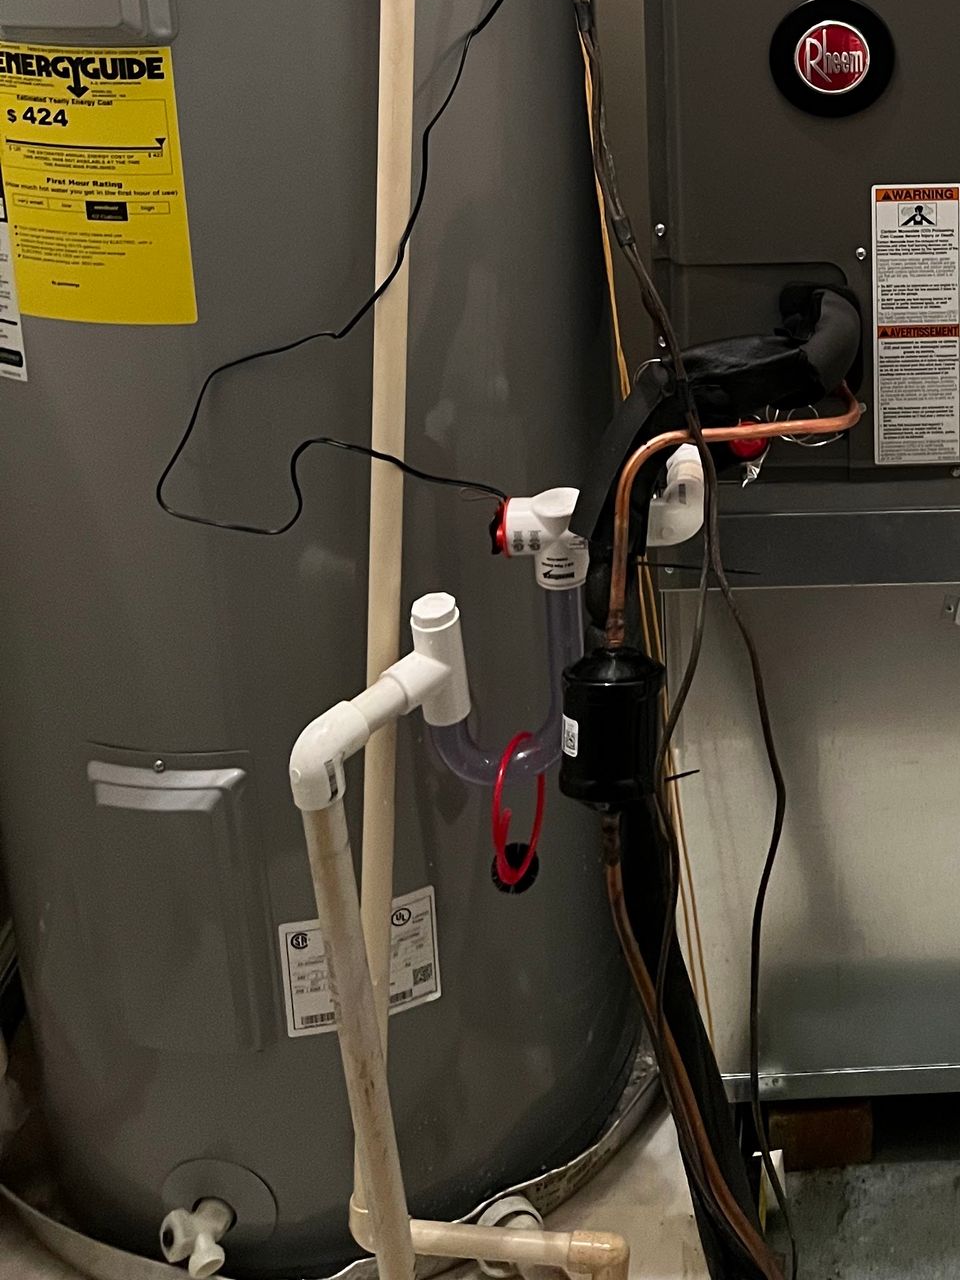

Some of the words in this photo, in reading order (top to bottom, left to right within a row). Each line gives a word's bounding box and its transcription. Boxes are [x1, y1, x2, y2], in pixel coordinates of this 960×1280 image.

[806, 29, 863, 83] Rheem
[16, 94, 47, 103] Estimated
[49, 97, 70, 106] Yearly
[7, 109, 17, 123] $
[22, 107, 69, 128] 424
[46, 177, 66, 186] First
[68, 179, 89, 187] Hour
[92, 180, 123, 189] Rating
[50, 186, 69, 194] water
[892, 189, 953, 200] WARNING
[890, 326, 958, 337] AVERTISSEMENT
